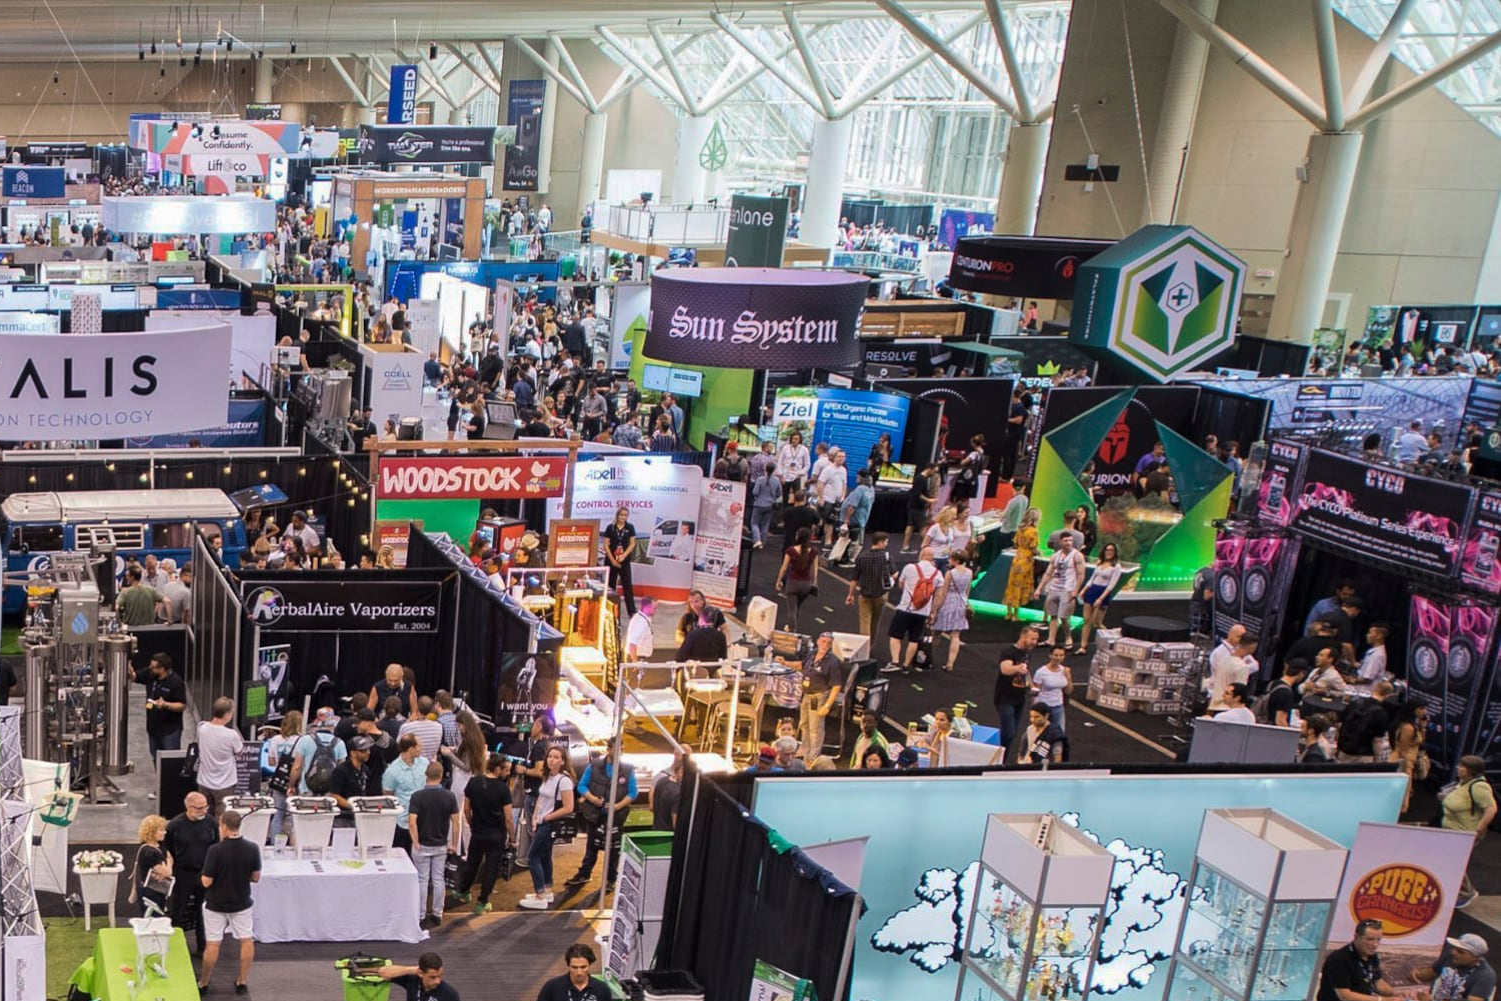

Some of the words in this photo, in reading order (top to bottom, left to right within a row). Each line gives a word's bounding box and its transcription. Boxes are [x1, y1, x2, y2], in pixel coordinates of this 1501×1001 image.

[203, 140, 254, 151] Confidently.
[207, 160, 248, 173] Lift&co
[733, 206, 774, 227] nlane
[669, 305, 726, 343] Sun
[731, 310, 840, 350] System
[28, 409, 154, 429] TECHNOLOGY
[779, 402, 815, 419] Ziel
[1271, 442, 1299, 460] CYCO
[382, 465, 522, 494] WOODSTOCK
[1364, 467, 1406, 496] CYCO
[575, 500, 615, 509] CONTROL
[616, 499, 655, 509] SERVICES
[1319, 499, 1342, 515] CYCO
[1342, 507, 1379, 527] Platinum
[1380, 517, 1408, 533] Series
[1408, 526, 1456, 547] Experience
[351, 602, 437, 622] Vaporizers
[393, 622, 412, 631] Est.
[414, 622, 433, 631] 2004
[1117, 644, 1144, 657] CYCO
[1135, 661, 1167, 672] CYCO
[1099, 695, 1127, 709] CYCO
[1127, 687, 1160, 700] CYCO
[506, 702, 530, 711] want
[531, 703, 549, 713] you
[1371, 866, 1437, 904] PUFF
